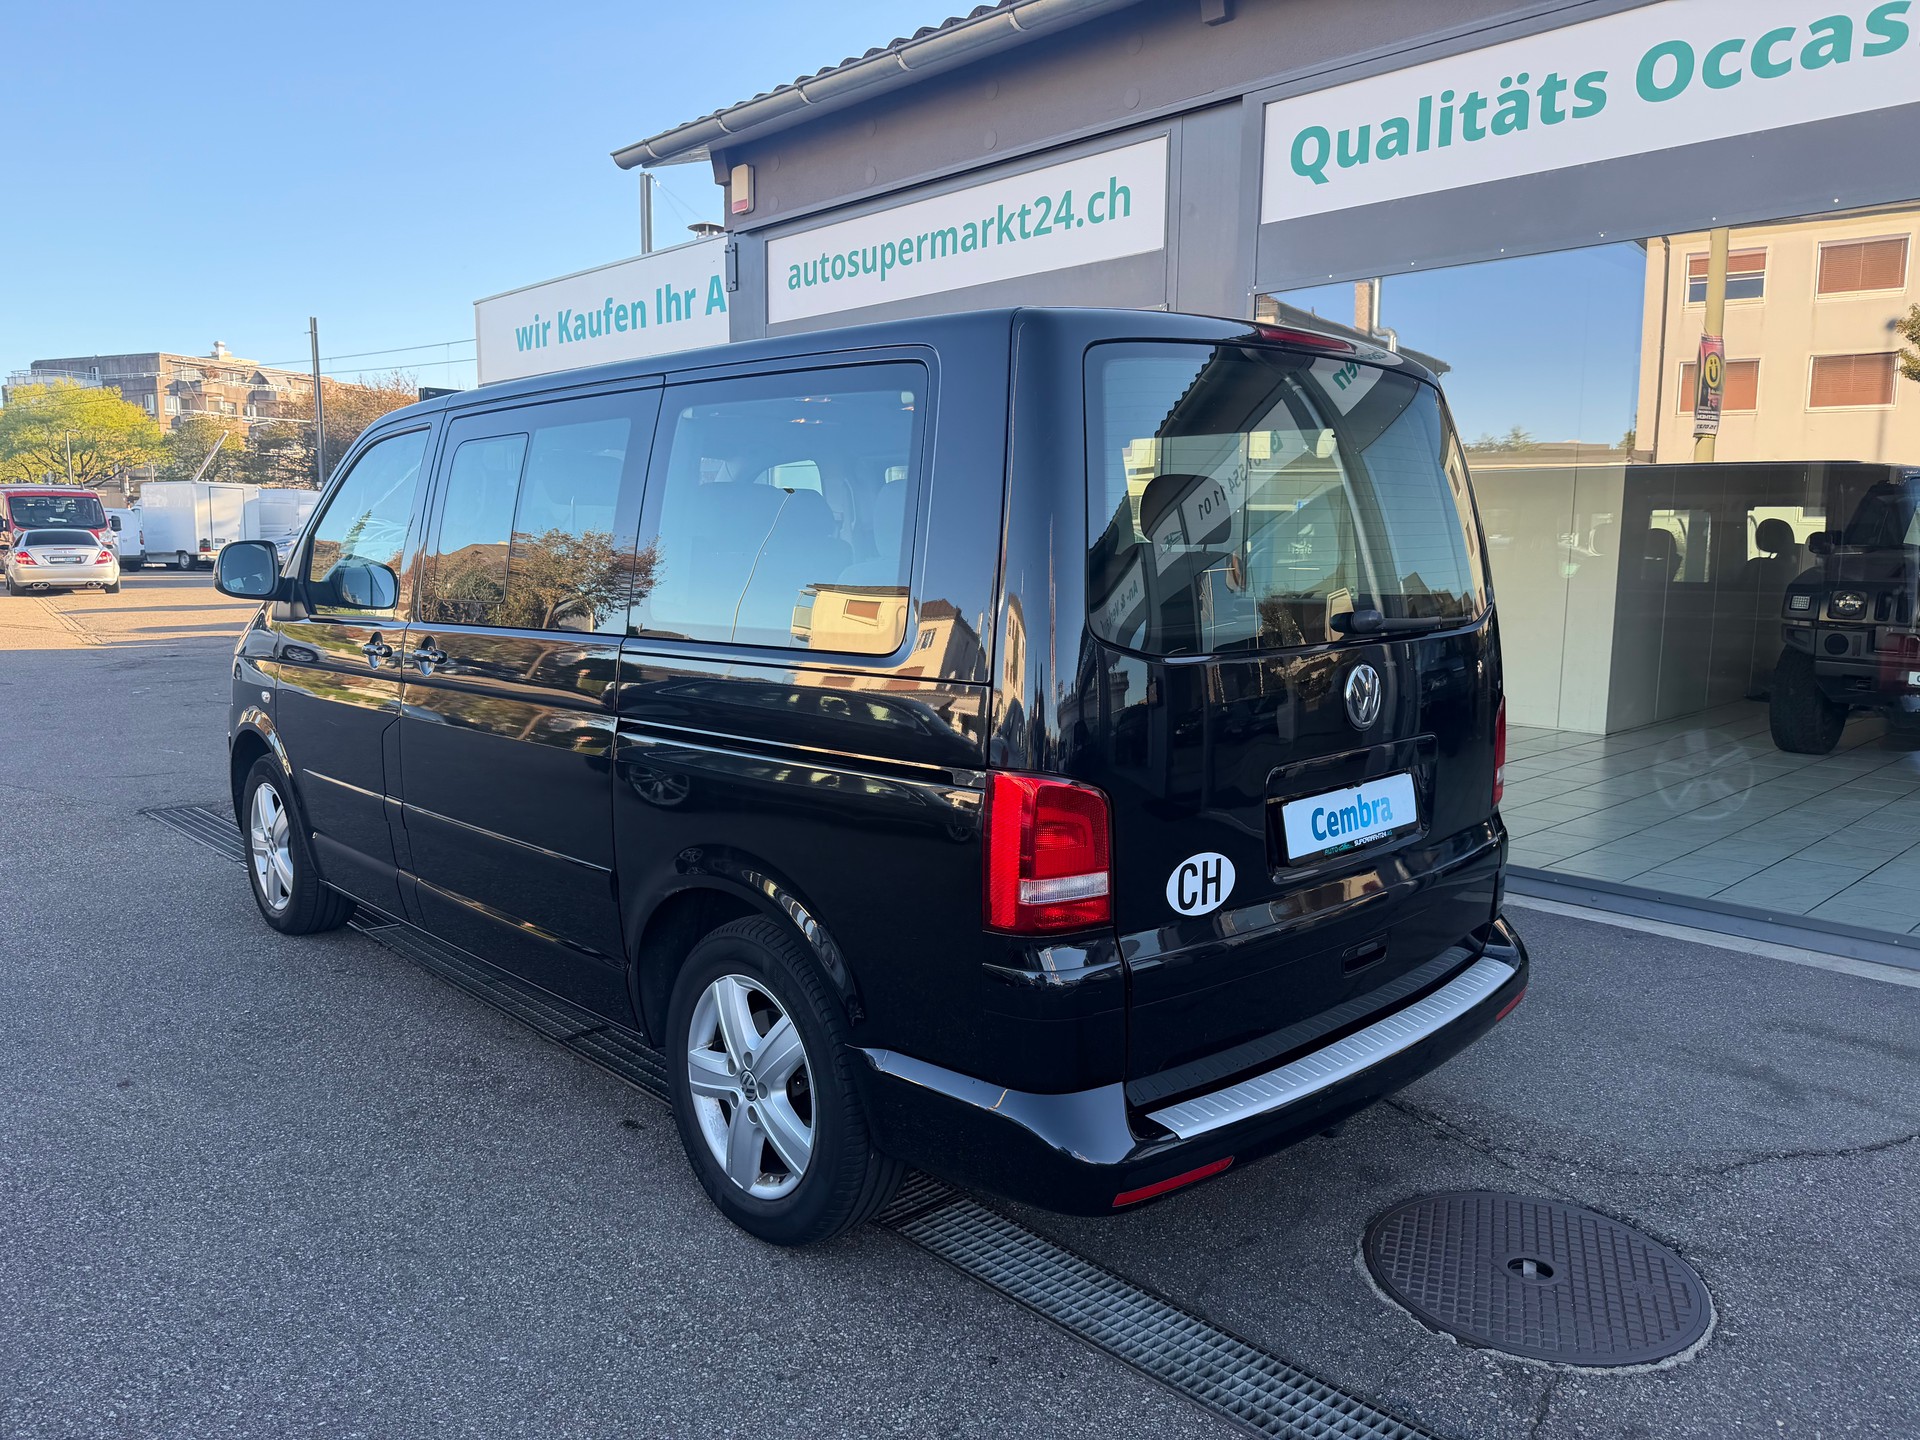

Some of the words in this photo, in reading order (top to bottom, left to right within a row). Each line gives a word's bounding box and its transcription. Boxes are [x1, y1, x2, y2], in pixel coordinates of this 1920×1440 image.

[1290, 71, 1608, 185] Qualitäts
[1635, 0, 1911, 102] Occas
[788, 176, 1132, 290] autosupermarkt24.ch
[515, 313, 552, 352] wir
[557, 297, 647, 344] Kaufen
[655, 283, 697, 325] Ihr
[705, 274, 727, 317] A
[1310, 793, 1394, 842] Cembra
[1177, 857, 1223, 911] CH
